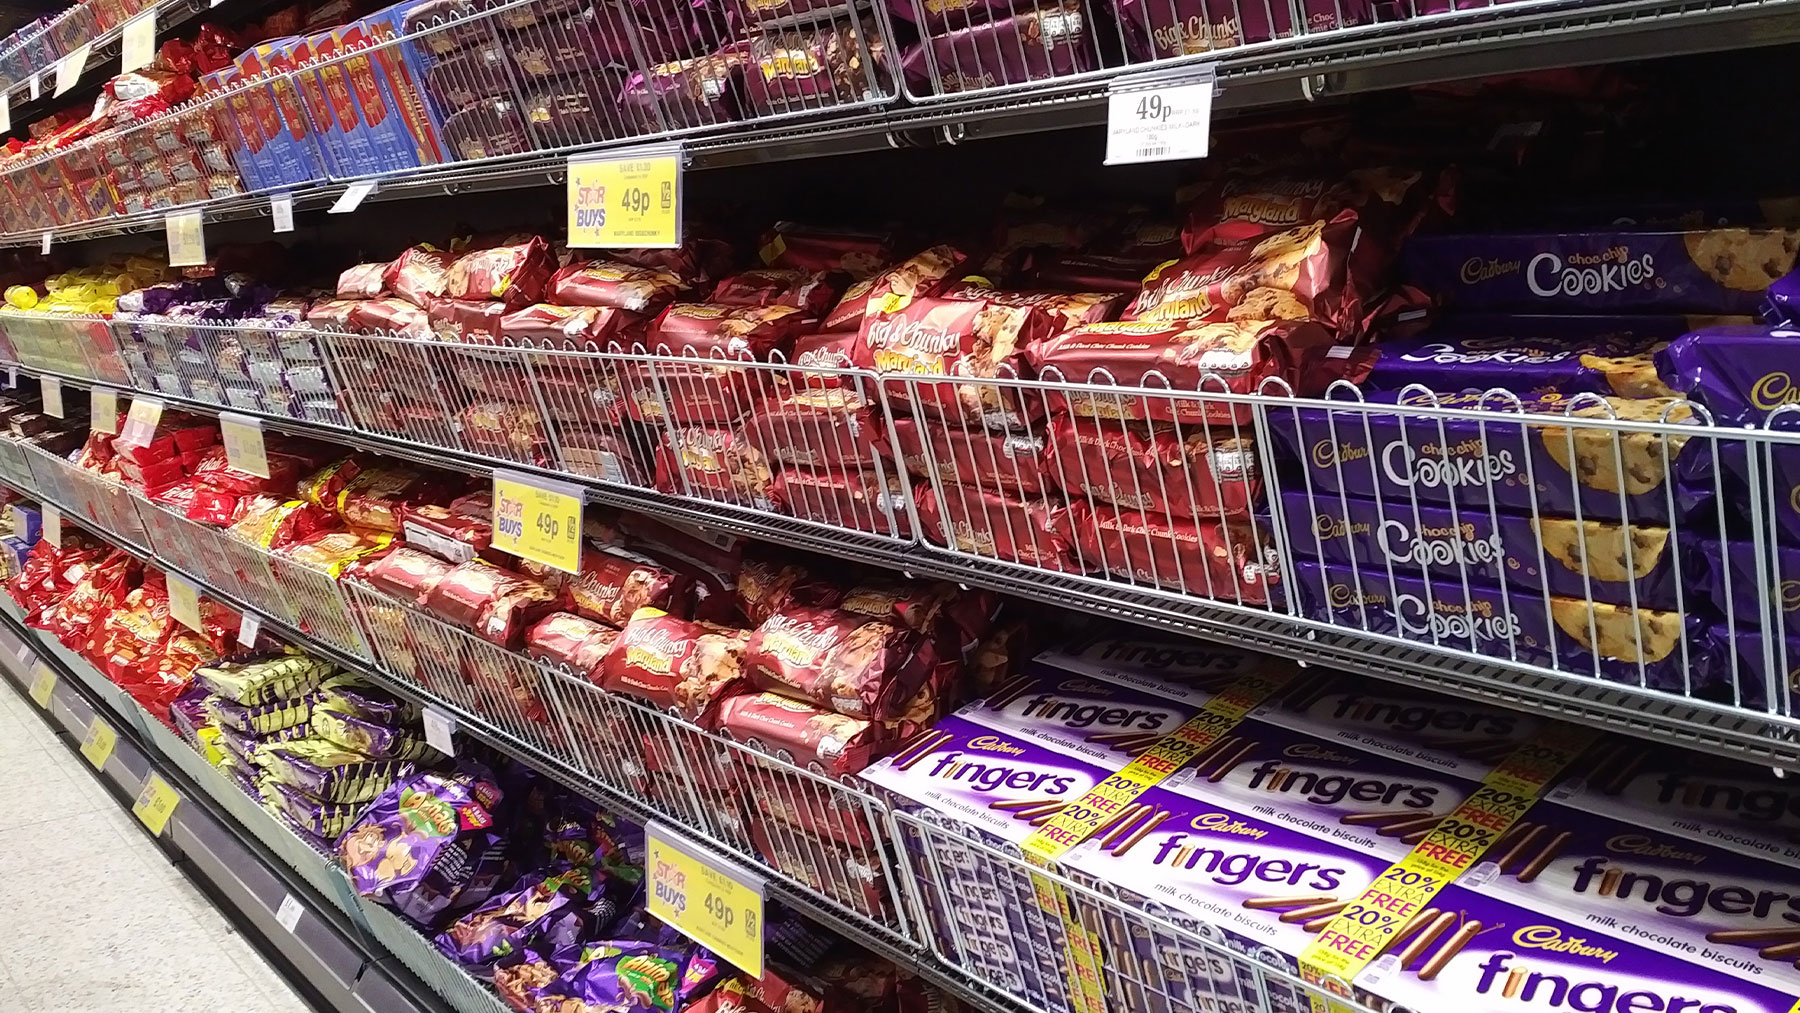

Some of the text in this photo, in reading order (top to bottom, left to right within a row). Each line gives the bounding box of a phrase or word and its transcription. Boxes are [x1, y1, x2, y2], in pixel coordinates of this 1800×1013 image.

[1153, 23, 1177, 51] Big
[1187, 15, 1241, 43] Chunky
[1136, 94, 1172, 122] 49p
[578, 187, 606, 205] STAR
[622, 187, 650, 216] 49p
[577, 208, 606, 228] BUYS
[1222, 197, 1301, 224] Maryland
[1459, 256, 1522, 285] Cadbury
[1568, 245, 1631, 268] choc chip
[1526, 252, 1655, 297] Cookies
[901, 321, 961, 356] Chunky
[1455, 439, 1485, 458] chip
[1382, 440, 1516, 487] Cookies
[500, 498, 523, 517] STAR
[499, 517, 523, 538] BUYS
[536, 513, 559, 539] 49p
[1376, 520, 1505, 566] Cookies
[584, 571, 621, 603] Chunky
[650, 629, 689, 658] Chunky
[794, 622, 839, 652] Chunky
[626, 648, 672, 675] Maryland
[1117, 671, 1156, 690] chocolate
[1156, 681, 1189, 698] biscuits
[1021, 694, 1169, 731] fingers
[1196, 711, 1238, 730] 20%
[1174, 727, 1215, 748] FREE
[1184, 720, 1224, 737] EXTRA
[966, 736, 1027, 760] Cadbury
[1019, 727, 1108, 760] milk chocolate biscuits
[1146, 746, 1186, 763] EXTRA
[1156, 736, 1198, 757] 20%
[1283, 742, 1361, 766] Cadbury
[1337, 729, 1458, 770] milk chocolate biscuits
[928, 750, 1077, 797] fingers
[1137, 753, 1177, 775] FREE
[1092, 784, 1132, 805] EXTRA
[1103, 774, 1148, 797] 20%
[1248, 760, 1440, 810] fingers
[403, 791, 457, 835] Animals
[924, 790, 1011, 830] milk chocolate biscuits
[1081, 792, 1122, 815] FREE
[1464, 799, 1517, 821] EXTRA
[1474, 787, 1532, 813] 20%
[1050, 813, 1090, 834] EXTRA
[1062, 804, 1107, 828] 20%
[1190, 812, 1268, 841] Cadbury
[1251, 802, 1378, 850] milk chocolate biscuits
[1452, 807, 1511, 832] FREE
[1037, 822, 1080, 846] FREE
[1427, 830, 1479, 857] EXTRA
[1437, 819, 1489, 849] 20%
[1672, 818, 1781, 854] milk chocolate
[1152, 832, 1348, 893] fingers
[1414, 842, 1472, 871] FREE
[1605, 834, 1707, 866] Cadbury
[656, 861, 687, 889] STAR
[1383, 867, 1435, 894] 20%
[655, 882, 687, 912] BUYS
[1359, 889, 1417, 918] FREE
[1373, 879, 1426, 905] EXTRA
[704, 893, 734, 928] 49p
[1154, 882, 1279, 937] milk chocolate biscuits
[1342, 905, 1395, 936] 20%
[1317, 930, 1373, 961] FREE
[1330, 919, 1384, 947] EXTRA
[1511, 924, 1620, 965] Cadbury
[1585, 911, 1764, 976] milk chocolate biscuits
